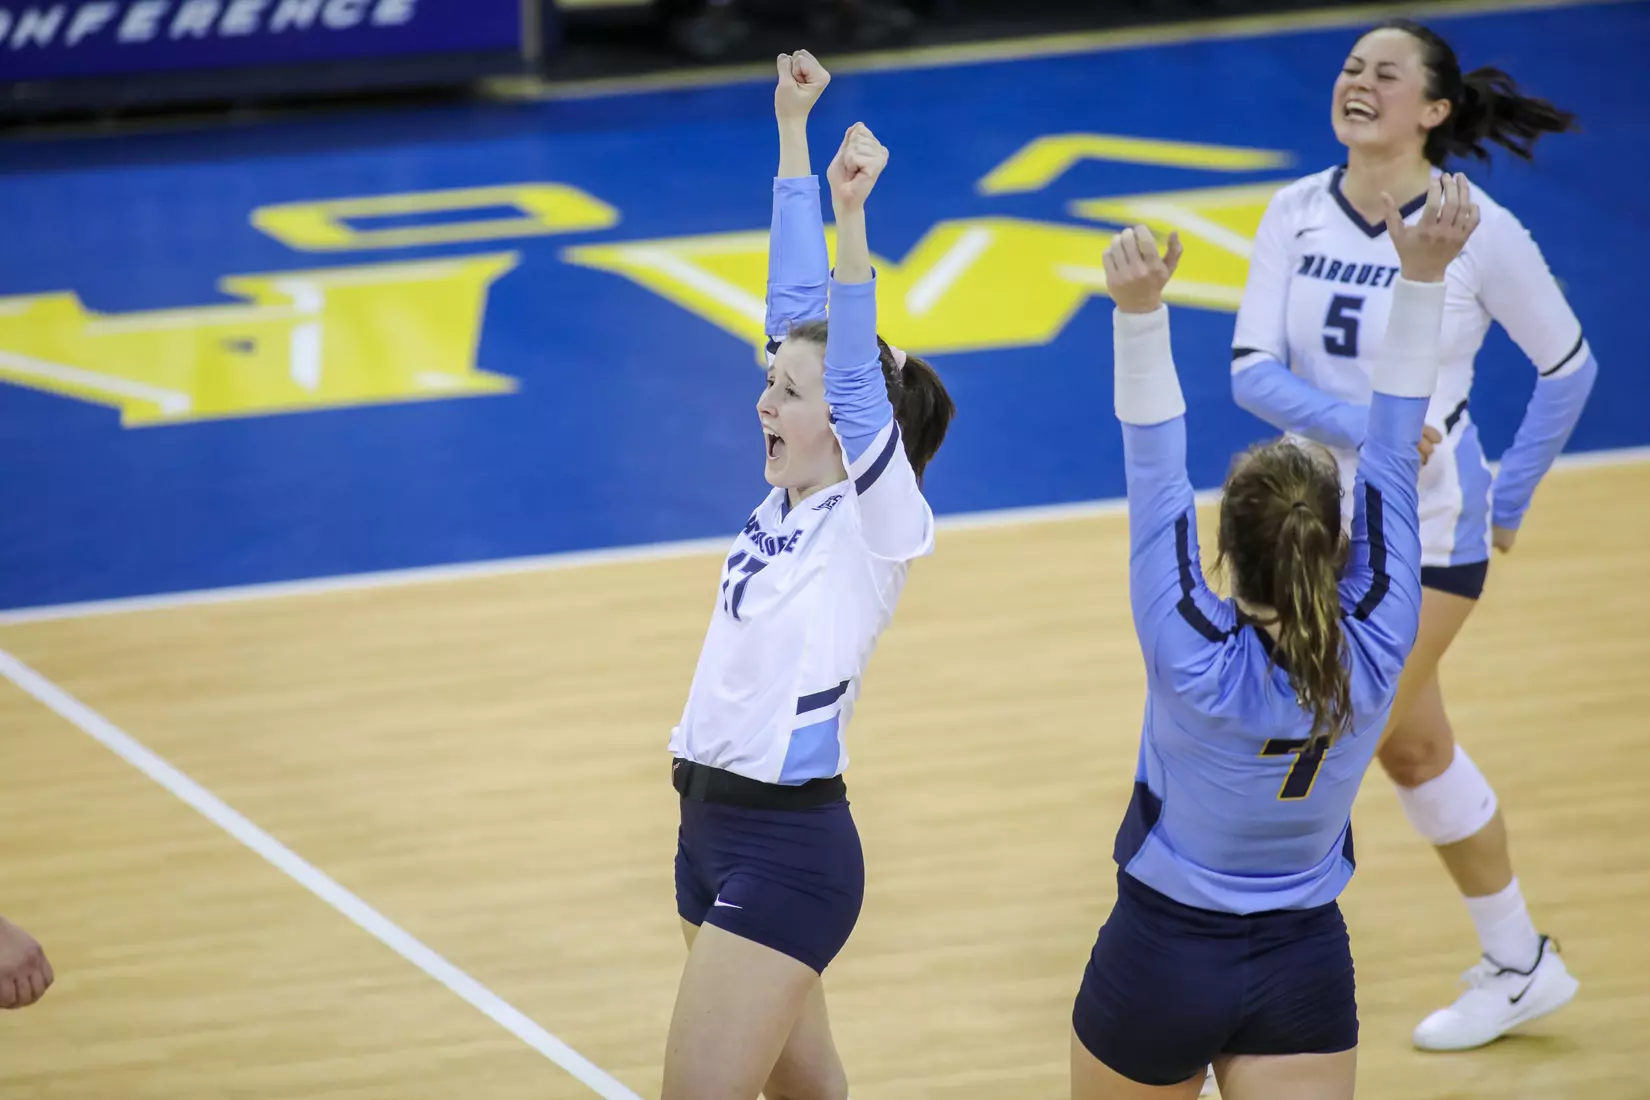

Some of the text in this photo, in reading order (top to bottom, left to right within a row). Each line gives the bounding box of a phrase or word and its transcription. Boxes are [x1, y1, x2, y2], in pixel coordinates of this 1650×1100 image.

[0, 0, 417, 50] NFERENCE
[1322, 292, 1367, 359] 5
[1258, 735, 1335, 800] 7
